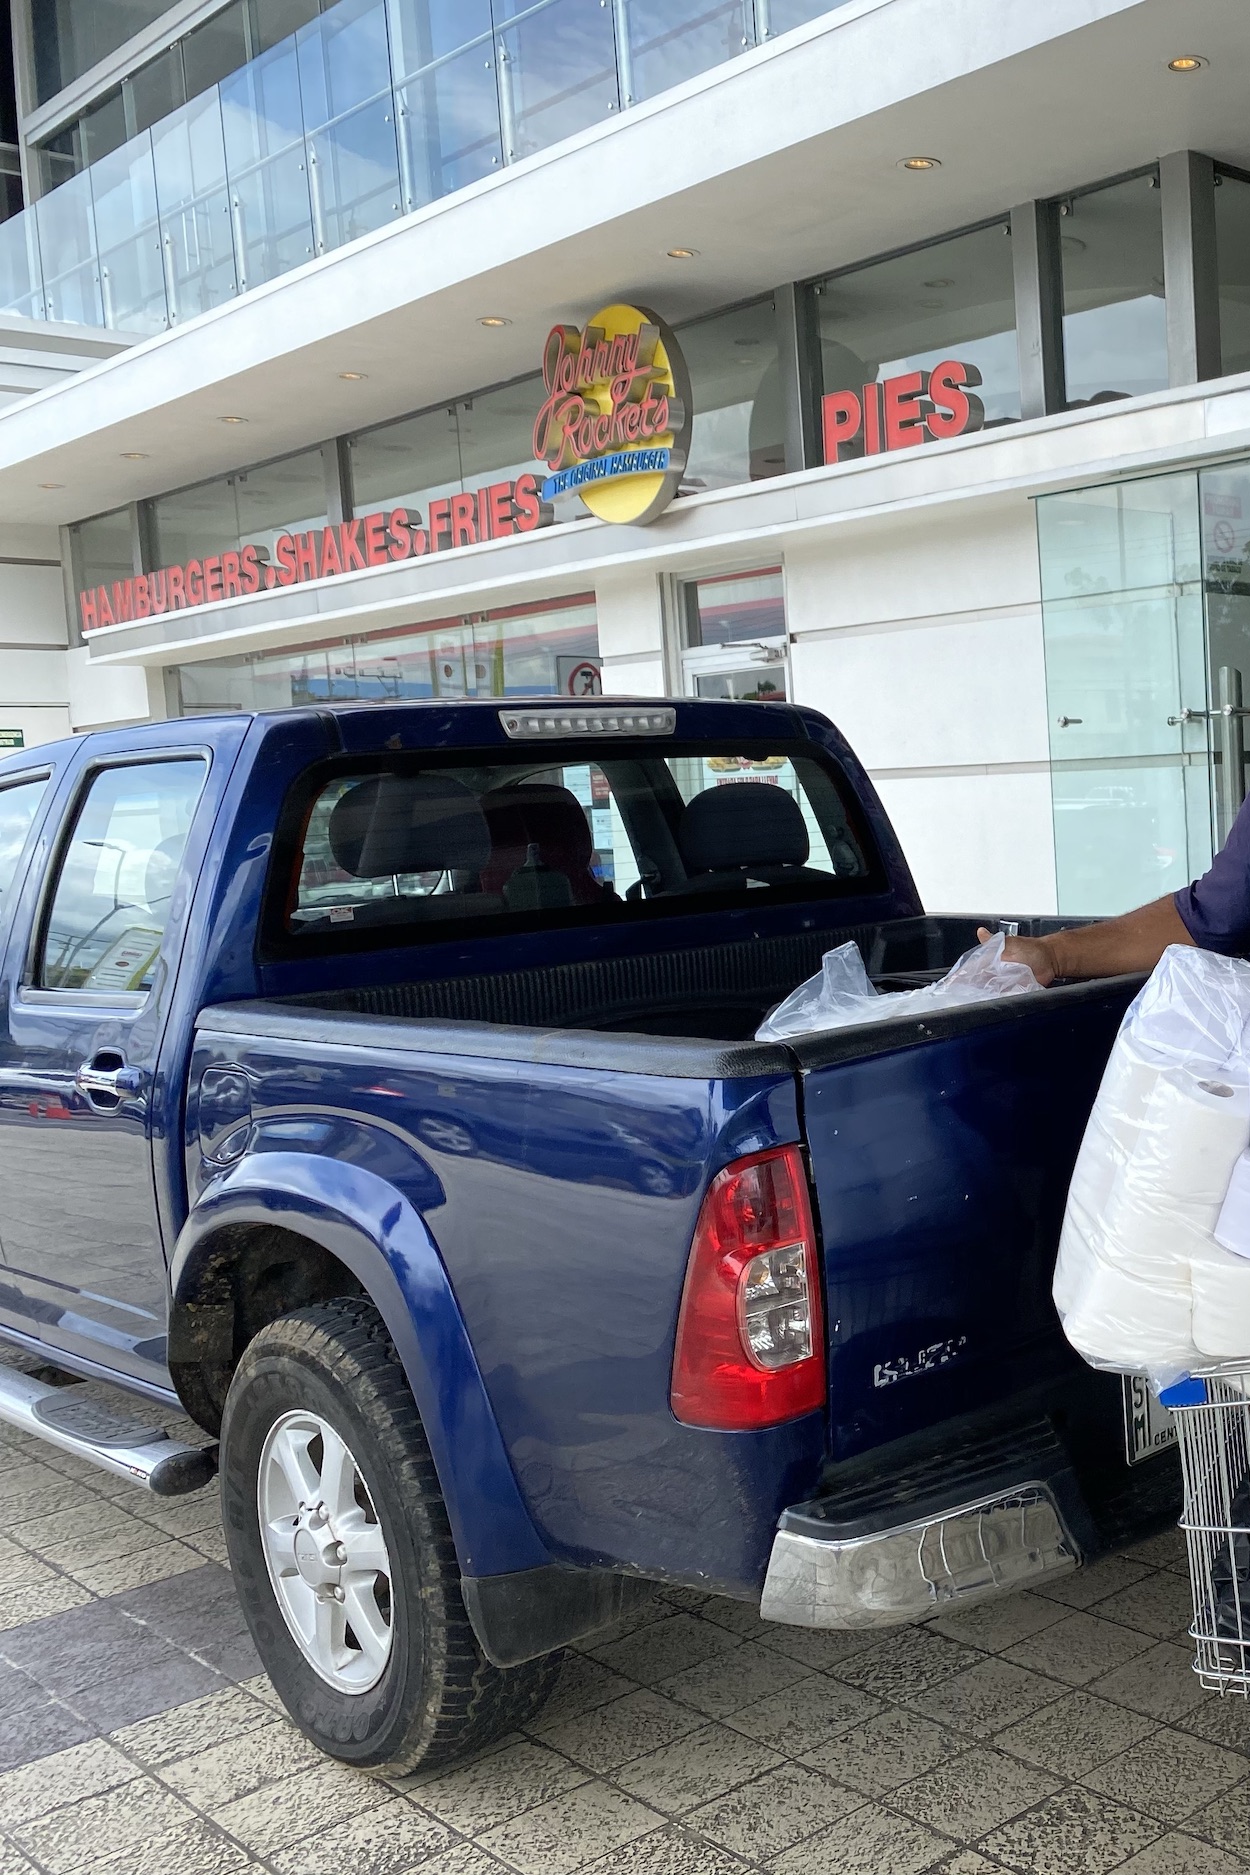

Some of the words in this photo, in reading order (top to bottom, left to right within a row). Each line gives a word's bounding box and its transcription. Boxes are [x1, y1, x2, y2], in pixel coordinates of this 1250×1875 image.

[533, 324, 652, 460] Johnny
[548, 383, 669, 470] Rockets
[821, 360, 970, 465] PIES
[429, 473, 540, 553] FRIES
[553, 474, 569, 494] THE
[570, 459, 609, 487] ORIGINAL
[610, 451, 665, 477] HAMBURGER
